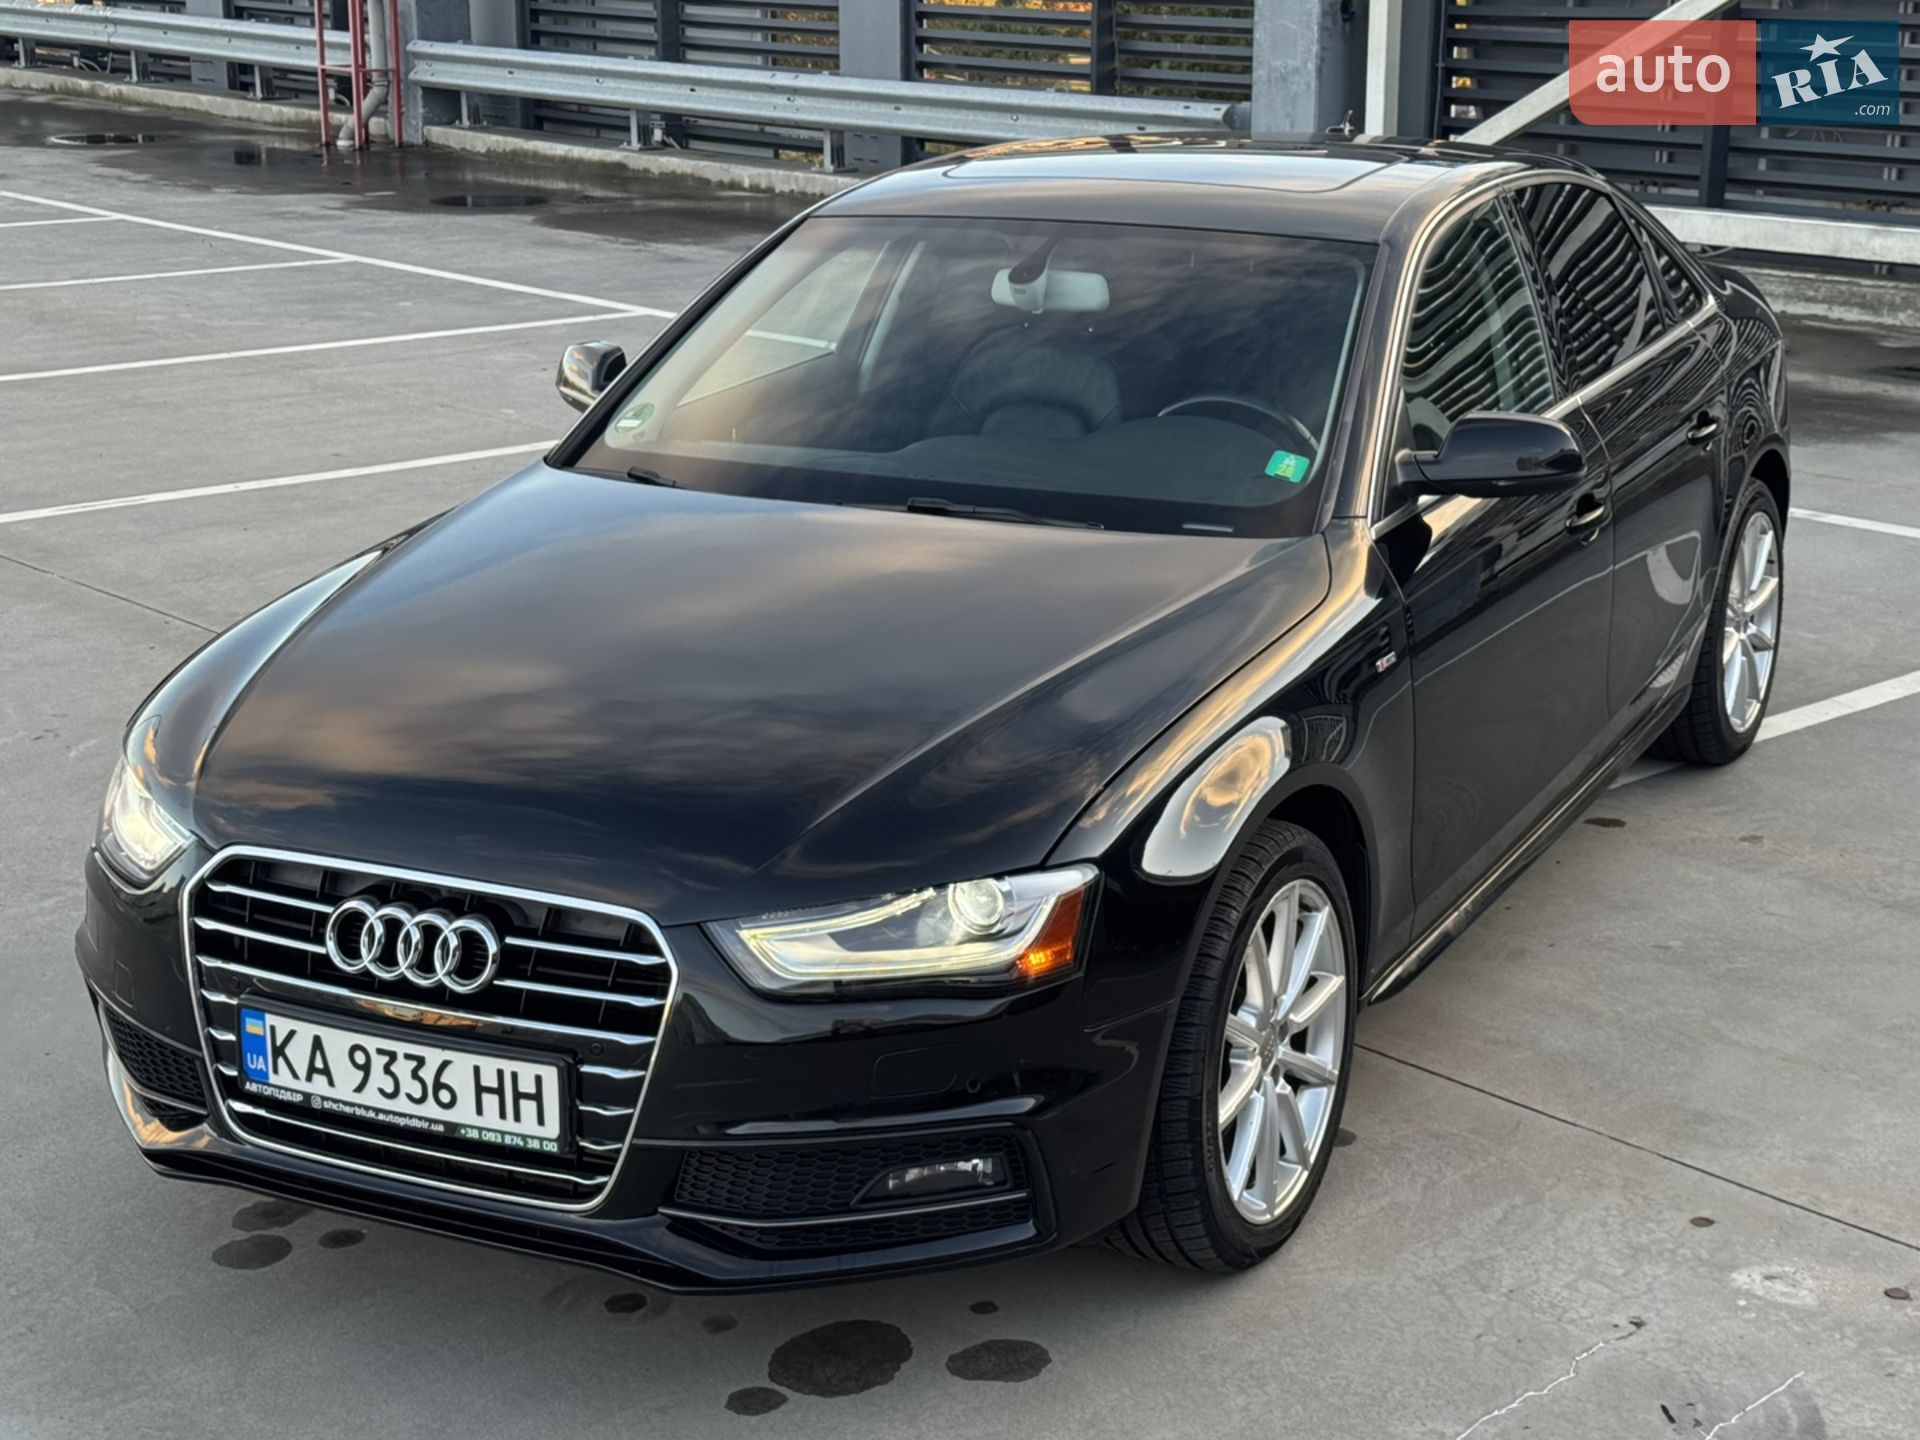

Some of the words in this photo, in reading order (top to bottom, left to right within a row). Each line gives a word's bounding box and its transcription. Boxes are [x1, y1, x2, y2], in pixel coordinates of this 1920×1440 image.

[247, 1052, 267, 1073] UA
[269, 1023, 336, 1089] KA
[347, 1043, 458, 1110] 9336
[473, 1064, 546, 1127] HH
[460, 1127, 479, 1139] +38
[482, 1130, 502, 1143] 093
[504, 1134, 524, 1147] 874
[526, 1138, 540, 1149] 38
[543, 1141, 558, 1152] 00
